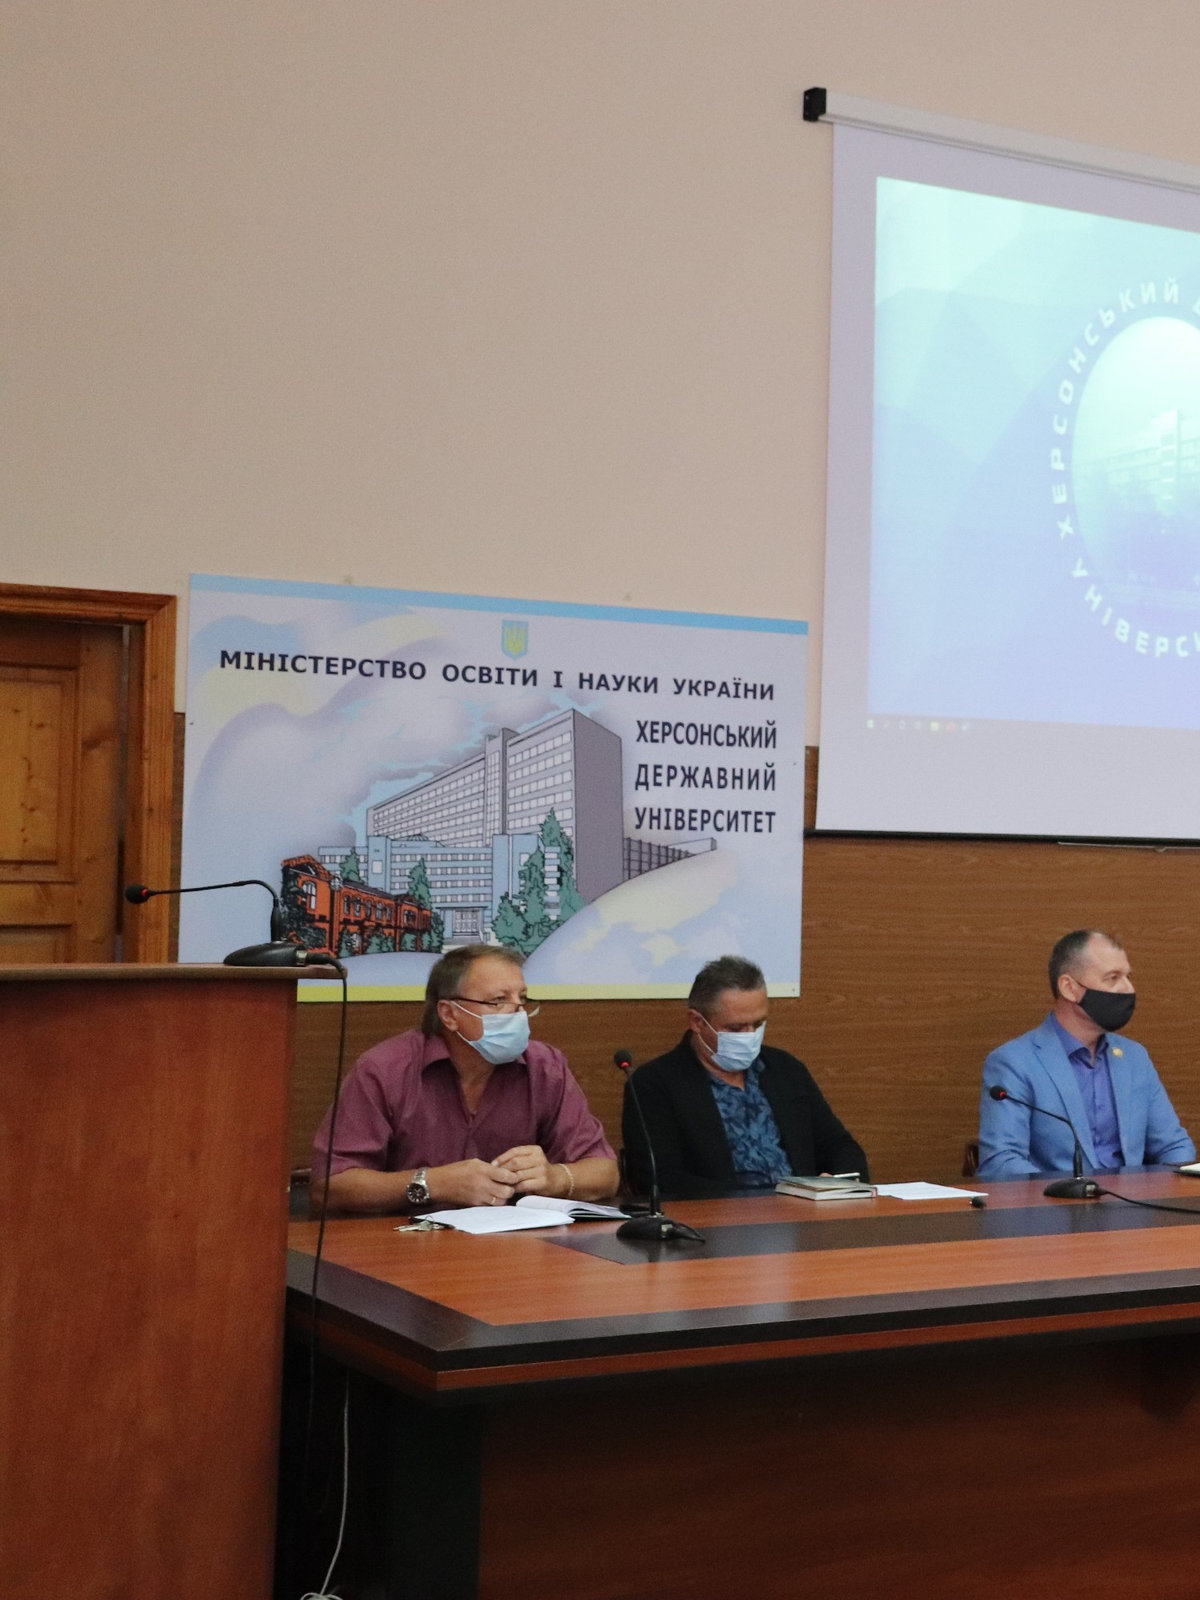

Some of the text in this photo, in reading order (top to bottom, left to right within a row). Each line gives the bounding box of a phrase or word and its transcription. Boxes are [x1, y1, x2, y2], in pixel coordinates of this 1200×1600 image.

[1050, 277, 1180, 540] ХЕРСОНСЬКИЙ
[219, 649, 775, 701] МІНІСТЕРСТВО ОСВІТИ І НАУКИ УКРАЇНИ
[635, 719, 778, 750] ХЕРСОНСЬКИЙ
[634, 761, 777, 792] ДЕРЖАВНИЙ
[634, 806, 777, 834] УНІВЕРСИТЕТ
